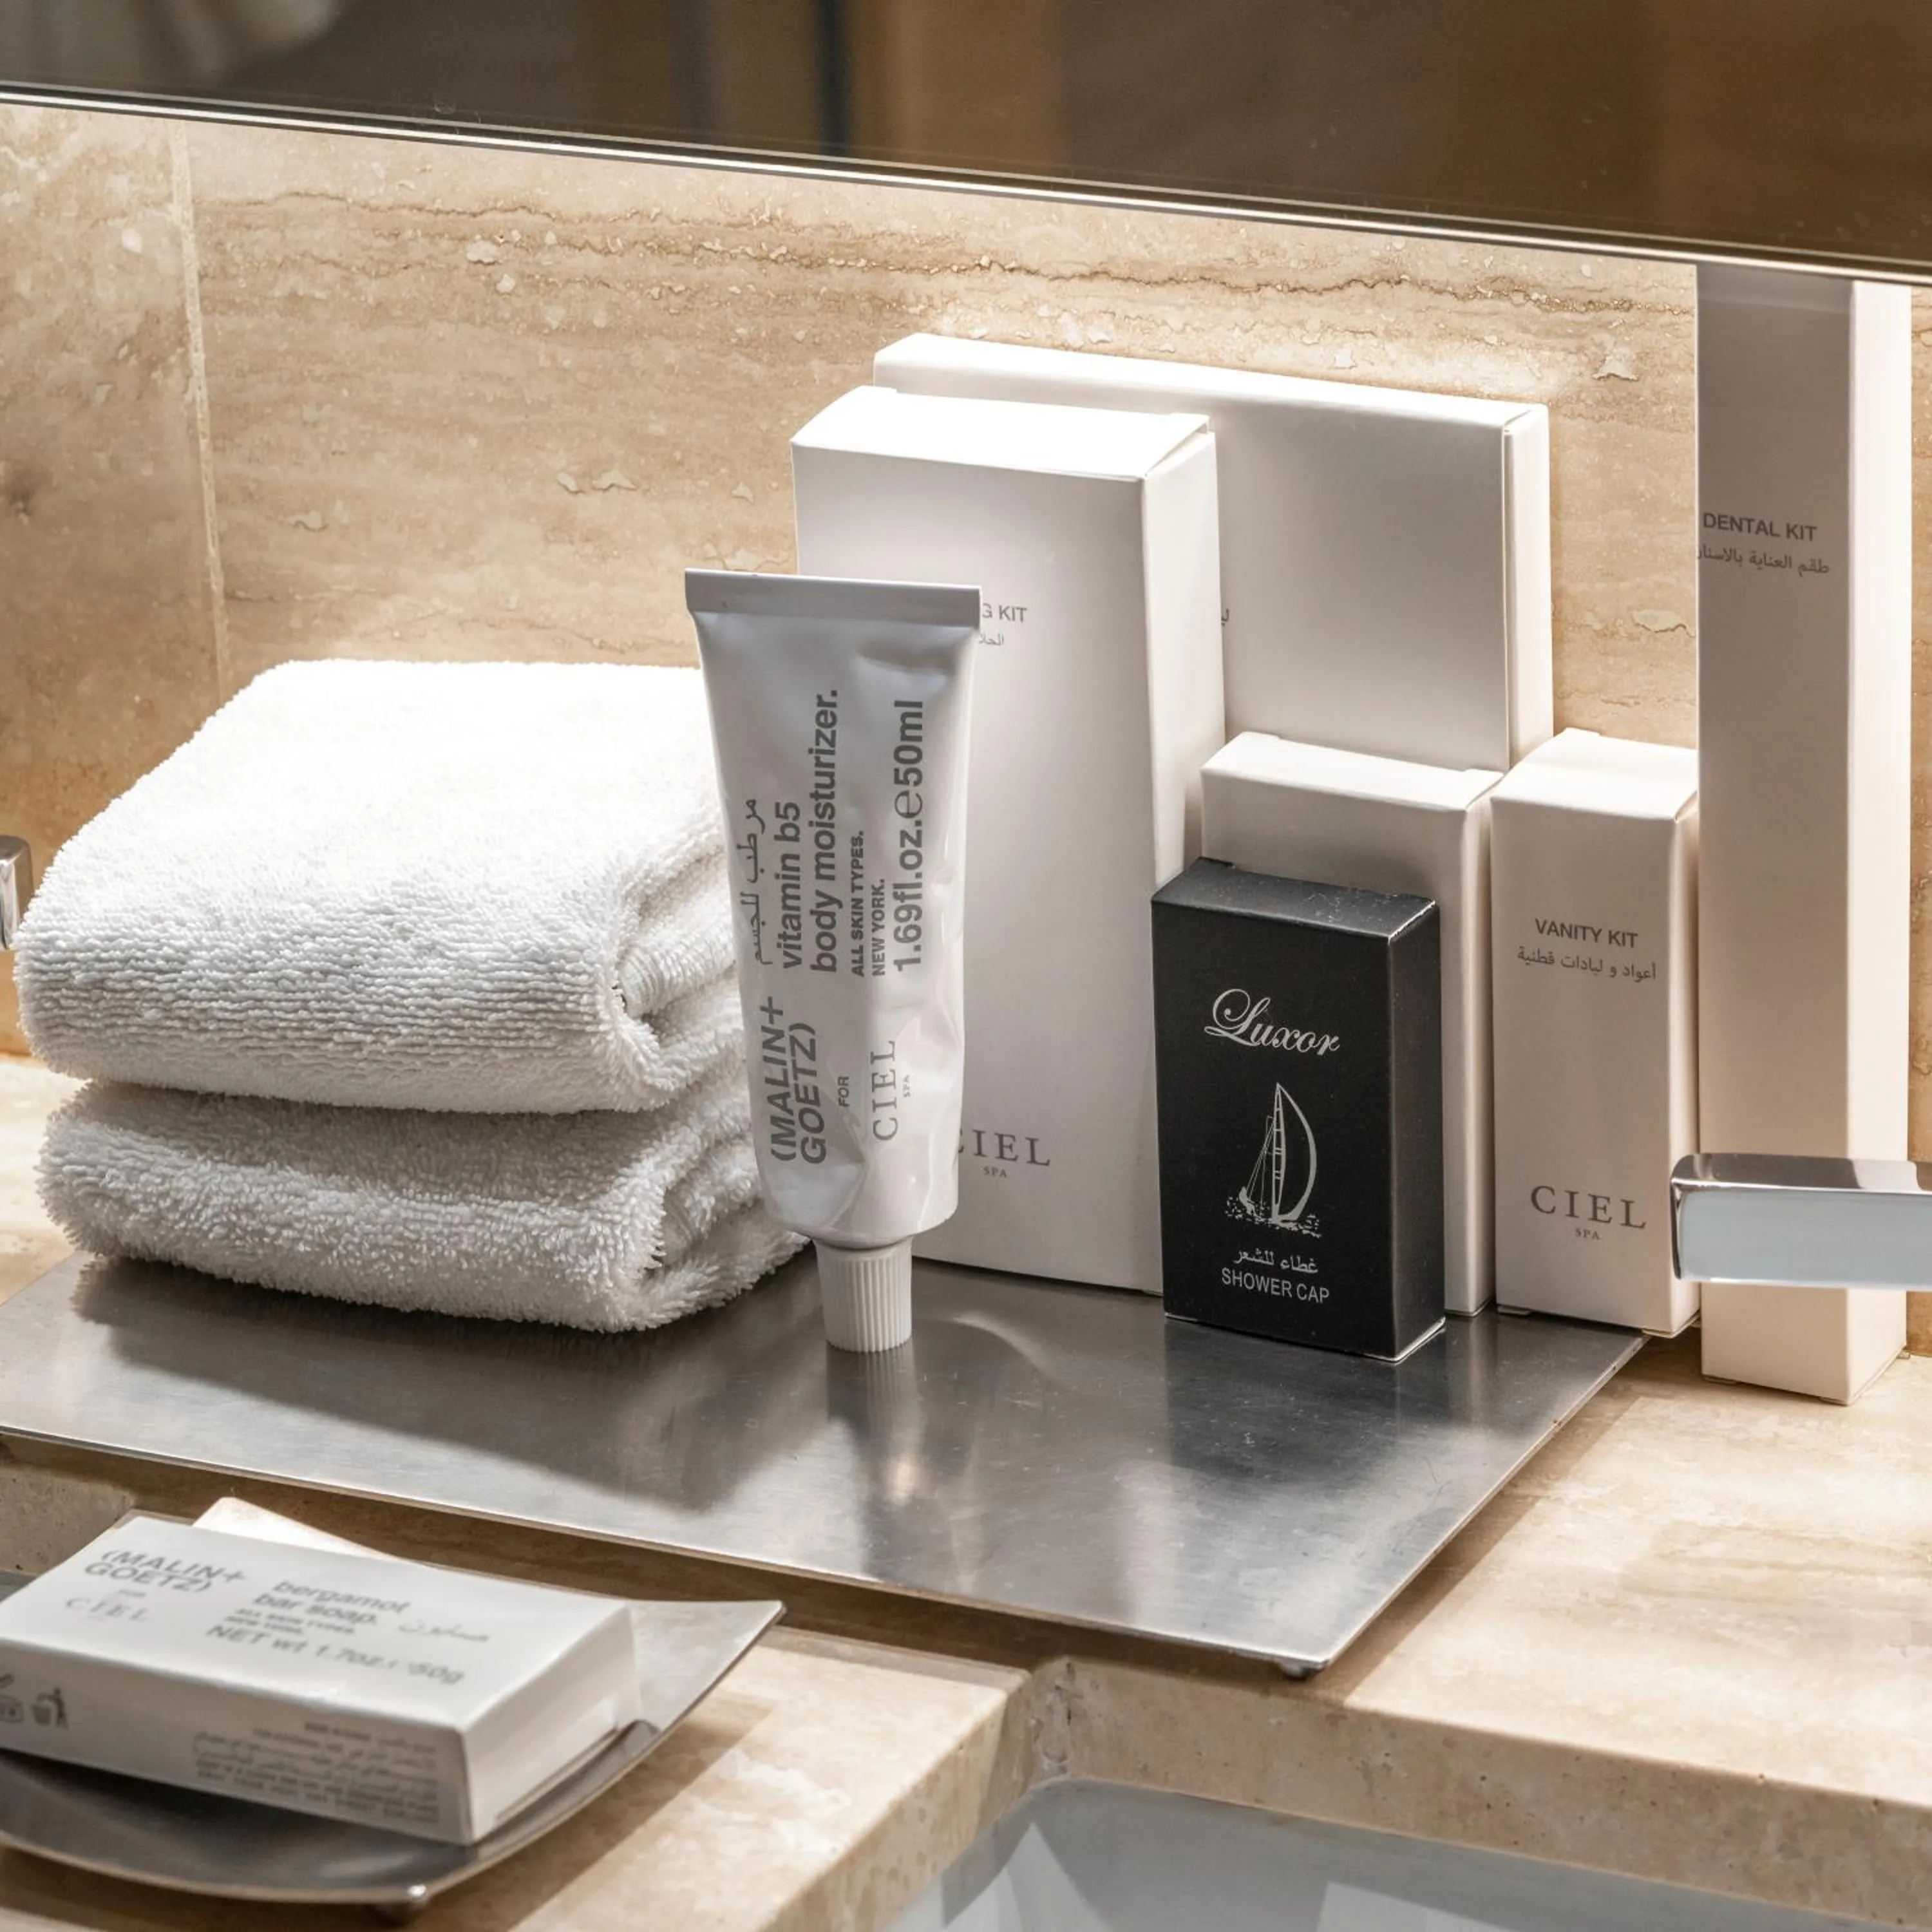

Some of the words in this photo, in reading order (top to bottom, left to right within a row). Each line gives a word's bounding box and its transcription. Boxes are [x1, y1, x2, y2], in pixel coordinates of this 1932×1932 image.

[1703, 513, 1780, 537] DENTAL
[1786, 523, 1817, 541] KIT
[1749, 550, 1792, 570] العناية
[1797, 558, 1830, 576] طقم
[999, 605, 1027, 622] KIT
[808, 690, 837, 881] moisturizer.
[774, 802, 801, 843] b5
[737, 799, 766, 883] مرطب
[851, 830, 864, 893] TYPES.
[774, 853, 802, 969] vitamin
[851, 898, 864, 940] SKIN
[871, 878, 885, 933] YORK.
[741, 892, 773, 965] للجسم
[810, 891, 842, 972] body
[1535, 918, 1602, 943] VANITY
[1608, 930, 1638, 948] KIT
[851, 945, 864, 977] ALL
[871, 937, 885, 976] NEW
[1517, 946, 1555, 966] قطنية
[1560, 956, 1603, 976] لبادات
[1609, 966, 1617, 978] و
[1204, 989, 1340, 1056] Luxor
[760, 996, 797, 1161] (MALIN+
[790, 1023, 827, 1164] GOETZ)
[838, 1076, 849, 1107] FOR
[871, 1040, 899, 1141] CIEL
[983, 1165, 1007, 1178] SPA
[1531, 1185, 1647, 1229] CIEL
[1576, 1227, 1600, 1240] SPA
[1233, 1247, 1274, 1265] للشعر
[1280, 1255, 1318, 1274] غطاء
[1222, 1267, 1293, 1298] SHOWER
[1296, 1283, 1330, 1303] CAP
[84, 1562, 212, 1592] GOETZ)
[101, 1549, 246, 1582] (MALIN+
[253, 1593, 305, 1610] bar
[273, 1580, 411, 1613] bergamot
[205, 1625, 272, 1645] NET
[271, 1638, 308, 1654] wt
